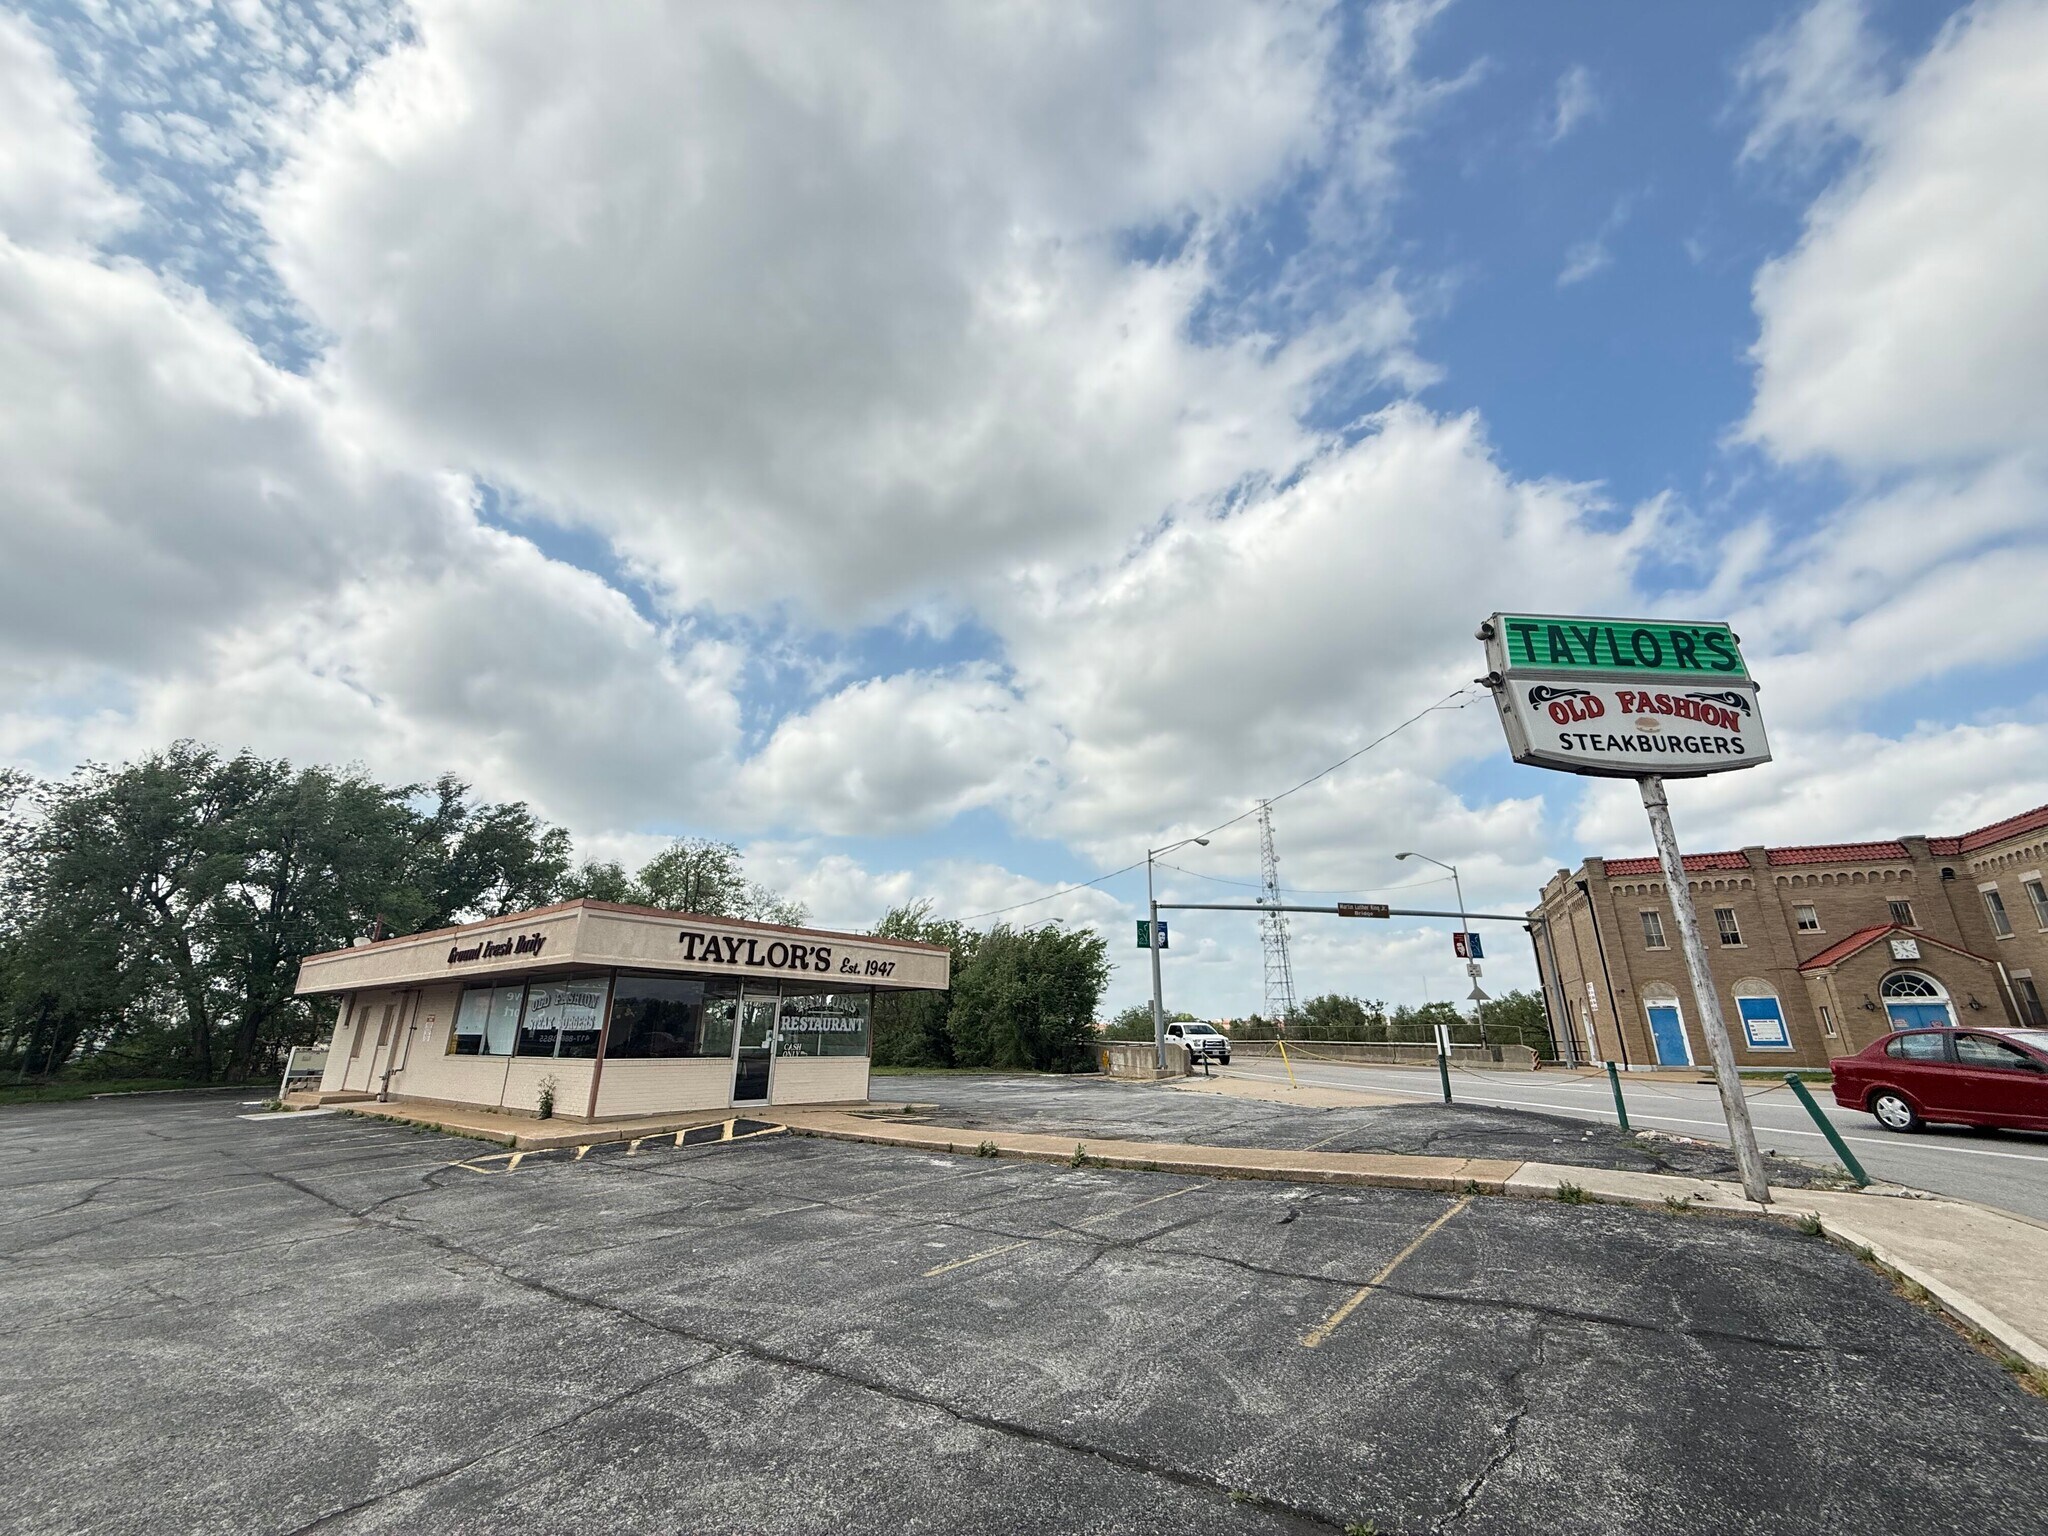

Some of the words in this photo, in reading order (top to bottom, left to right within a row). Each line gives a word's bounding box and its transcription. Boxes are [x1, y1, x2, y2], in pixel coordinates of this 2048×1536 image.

[1509, 623, 1737, 672] TAYLOR'S
[1547, 695, 1605, 726] OLD
[1615, 690, 1741, 733] FASHION
[1558, 732, 1746, 755] STEAKBURGERS
[447, 942, 484, 964] Ground
[482, 937, 513, 959] Fresh
[513, 932, 547, 957] Daily
[679, 931, 832, 972] TAYLOR'S
[839, 957, 861, 975] Est.
[864, 959, 896, 977] 1947
[531, 994, 551, 1012] OLD
[780, 1015, 865, 1032] RESTAURANT
[783, 1043, 802, 1051] CASH
